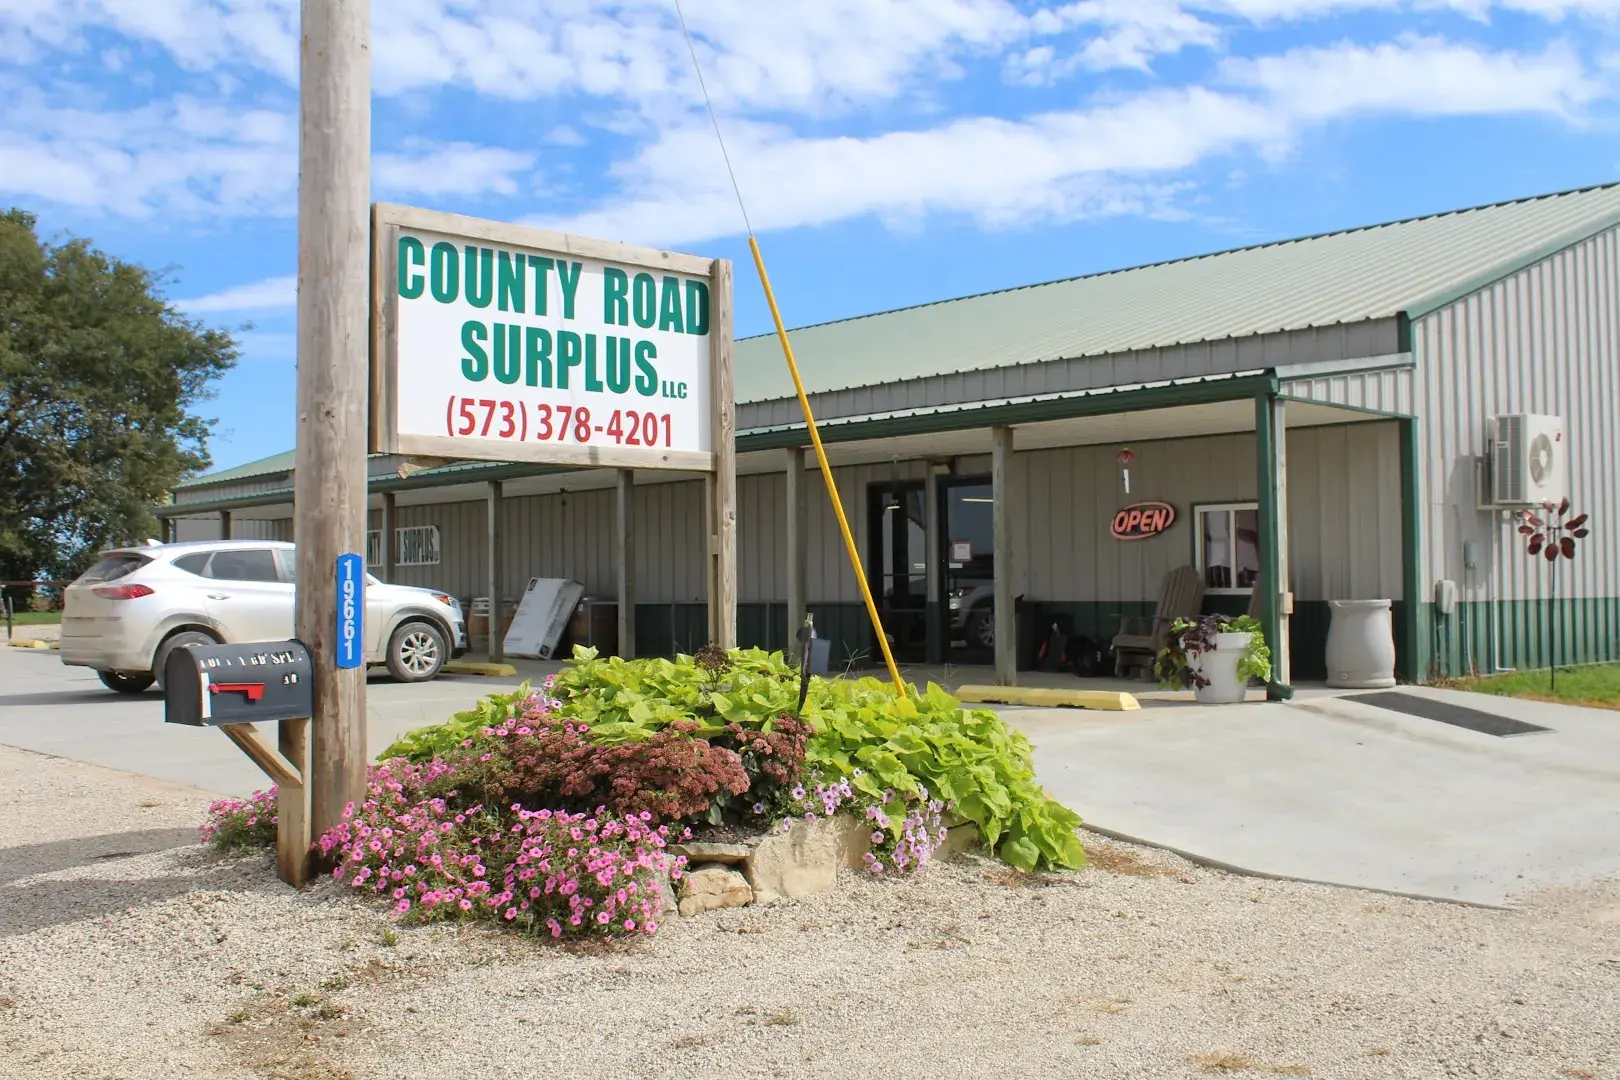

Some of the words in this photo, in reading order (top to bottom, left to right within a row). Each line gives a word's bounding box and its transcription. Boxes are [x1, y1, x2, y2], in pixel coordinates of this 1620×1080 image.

[398, 236, 583, 320] COUNTY
[603, 266, 709, 336] ROAD
[461, 320, 658, 397] SURPLUS
[662, 380, 688, 399] LLC
[446, 395, 528, 442] (573)
[537, 404, 672, 447] 378-4201
[404, 528, 434, 564] SURPLUS
[1114, 509, 1167, 533] OPEN
[343, 559, 355, 660] 19661
